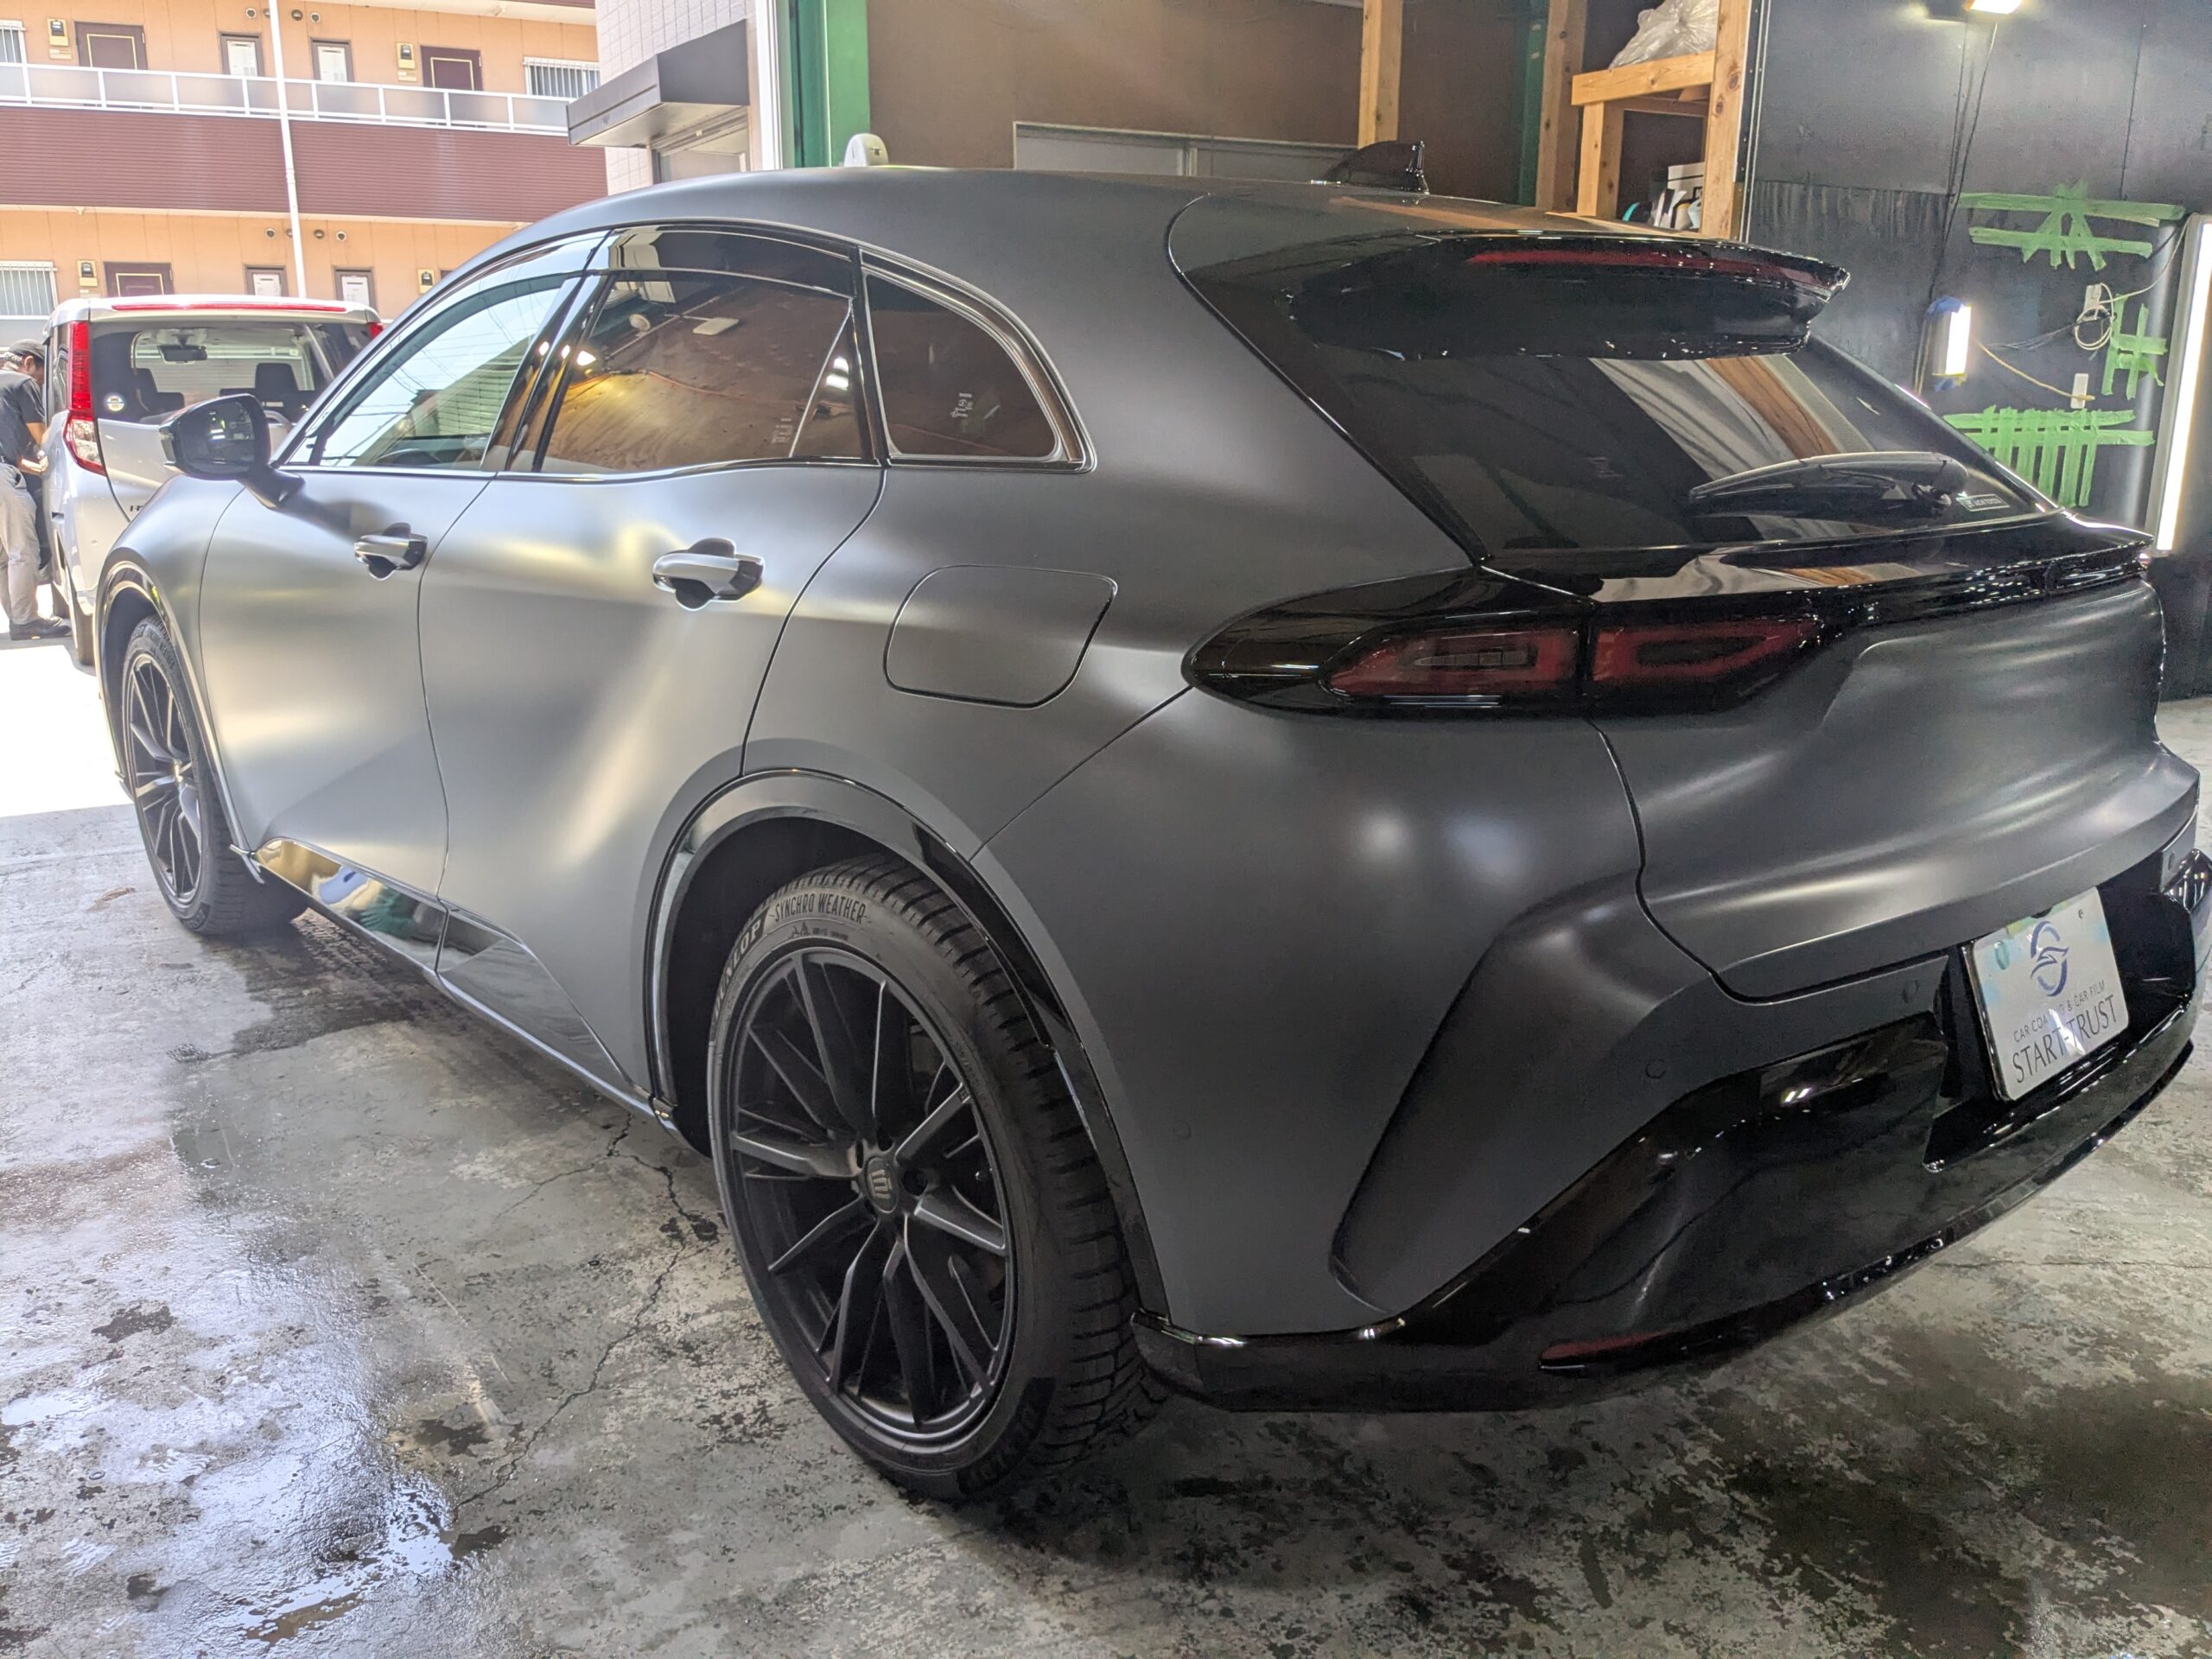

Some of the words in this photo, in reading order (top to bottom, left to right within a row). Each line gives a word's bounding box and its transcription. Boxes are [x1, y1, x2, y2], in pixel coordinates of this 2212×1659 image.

[775, 893, 815, 922] SYNCHRO
[818, 893, 867, 925] WEATHER
[2012, 994, 2117, 1084] START-TRUST
[2013, 1025, 2030, 1043] CAR
[2031, 1003, 2065, 1033] COAG
[2067, 1000, 2073, 1012] &
[2074, 989, 2089, 1007] CAR
[2089, 980, 2106, 996] FILM
